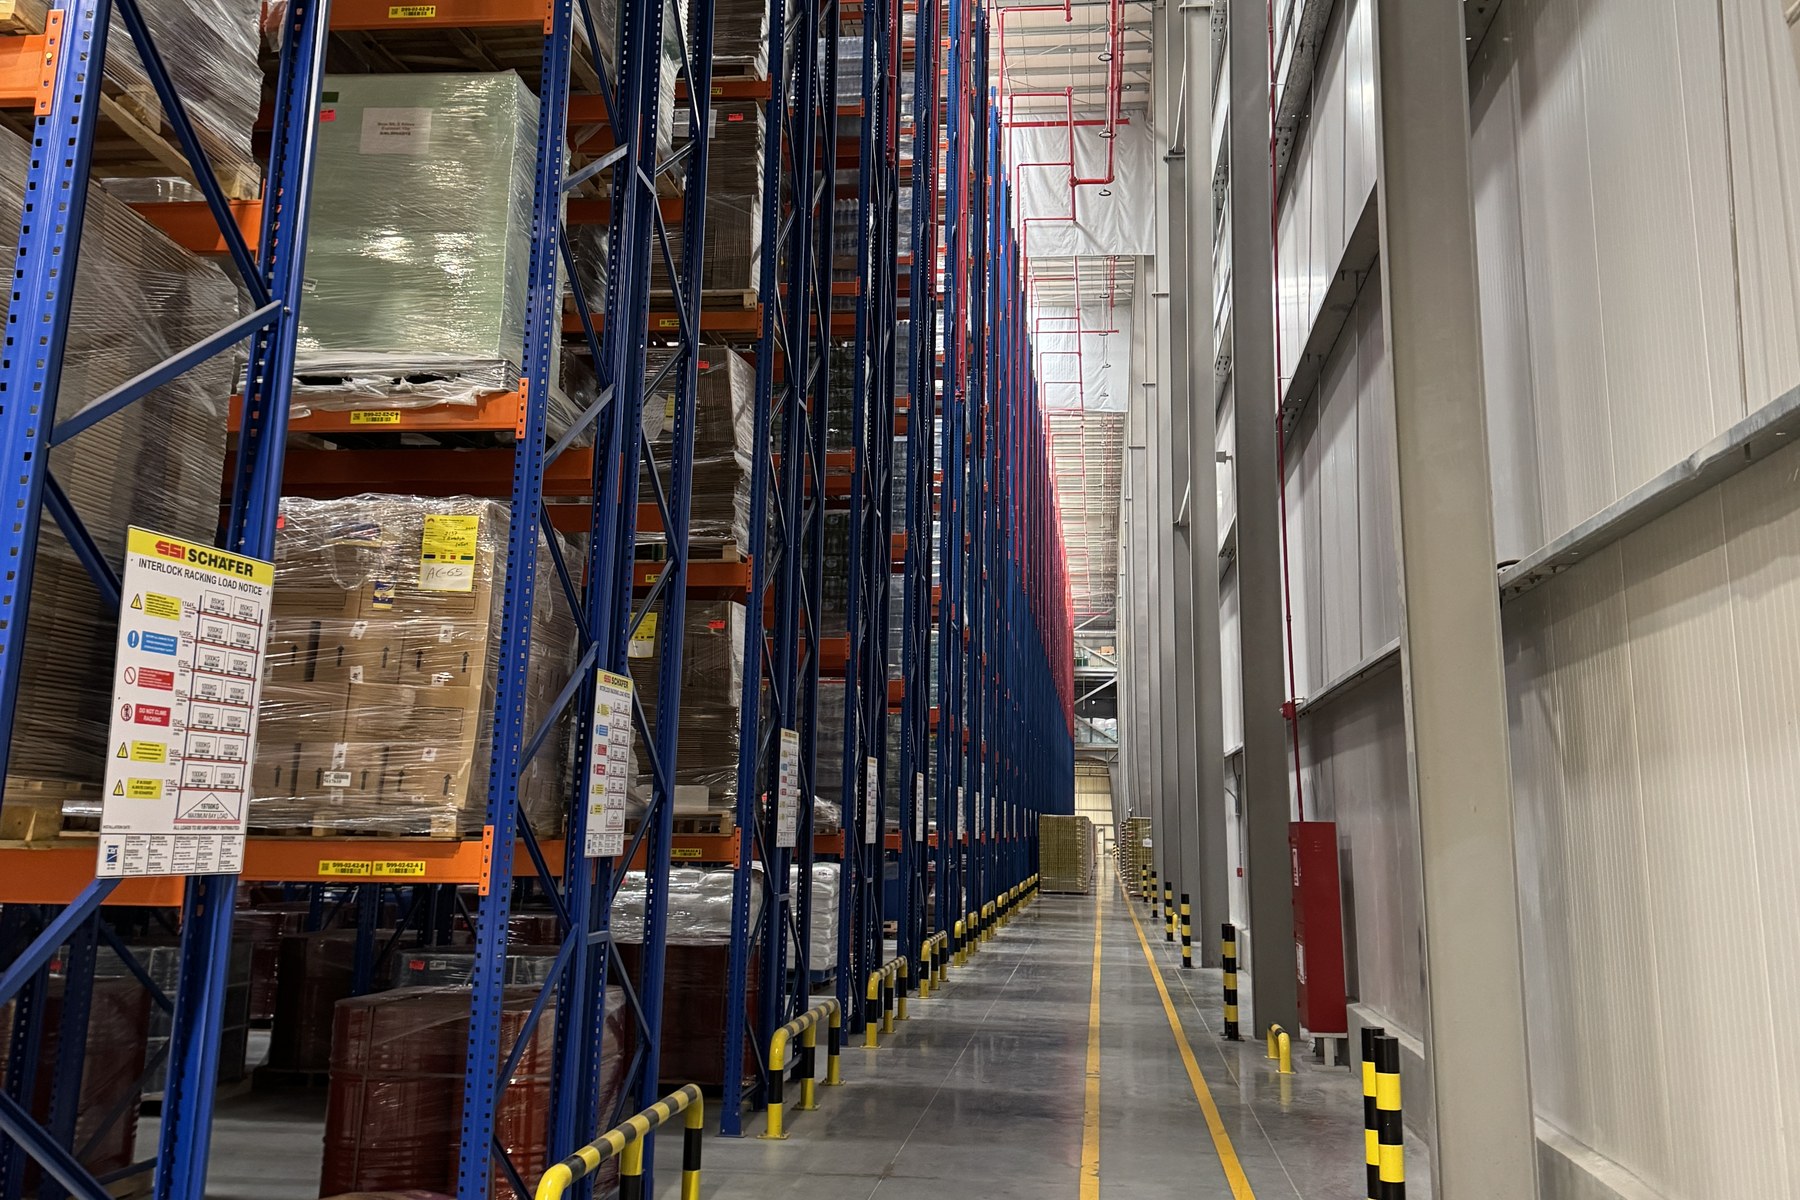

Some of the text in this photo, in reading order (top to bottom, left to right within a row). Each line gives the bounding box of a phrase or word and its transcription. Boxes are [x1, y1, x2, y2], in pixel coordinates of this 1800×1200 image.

[139, 558, 262, 596] INTERLOCK RACKING LOAD NOTICE
[156, 540, 253, 577] SSI SCHÄFER
